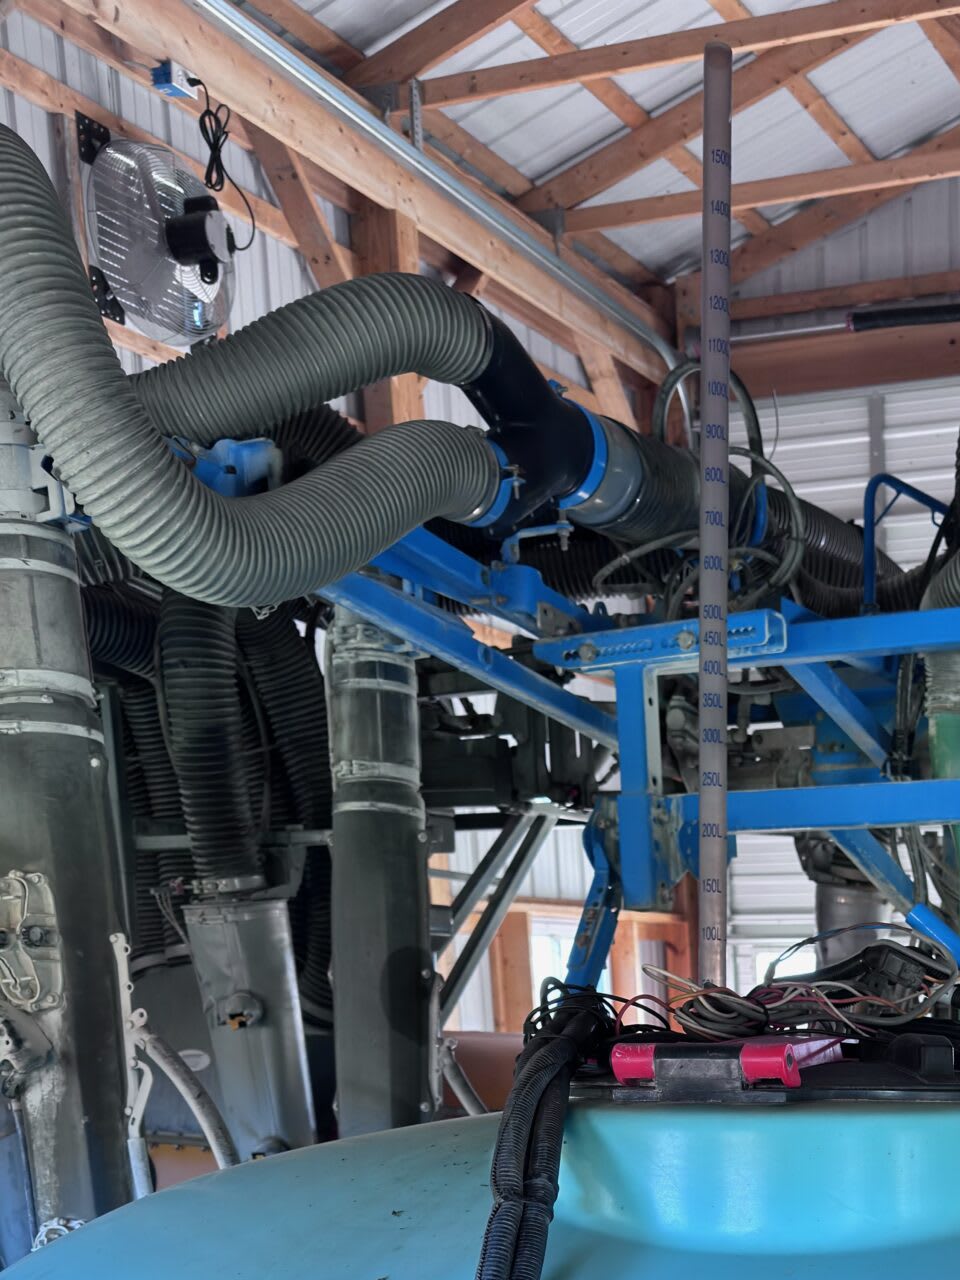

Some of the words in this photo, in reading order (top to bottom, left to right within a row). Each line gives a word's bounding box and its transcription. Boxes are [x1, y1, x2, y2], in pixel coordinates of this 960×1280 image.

[705, 424, 727, 440] 900L
[704, 467, 727, 484] 800L
[704, 511, 726, 527] 700L
[703, 555, 725, 572] 600L
[703, 631, 724, 647] 450L
[703, 660, 724, 676] 400L
[702, 692, 723, 708] 350L
[702, 728, 723, 744] 300L
[702, 771, 723, 787] 250L
[701, 823, 722, 838] 200L
[701, 878, 722, 893] 150L
[701, 926, 722, 941] 100L
